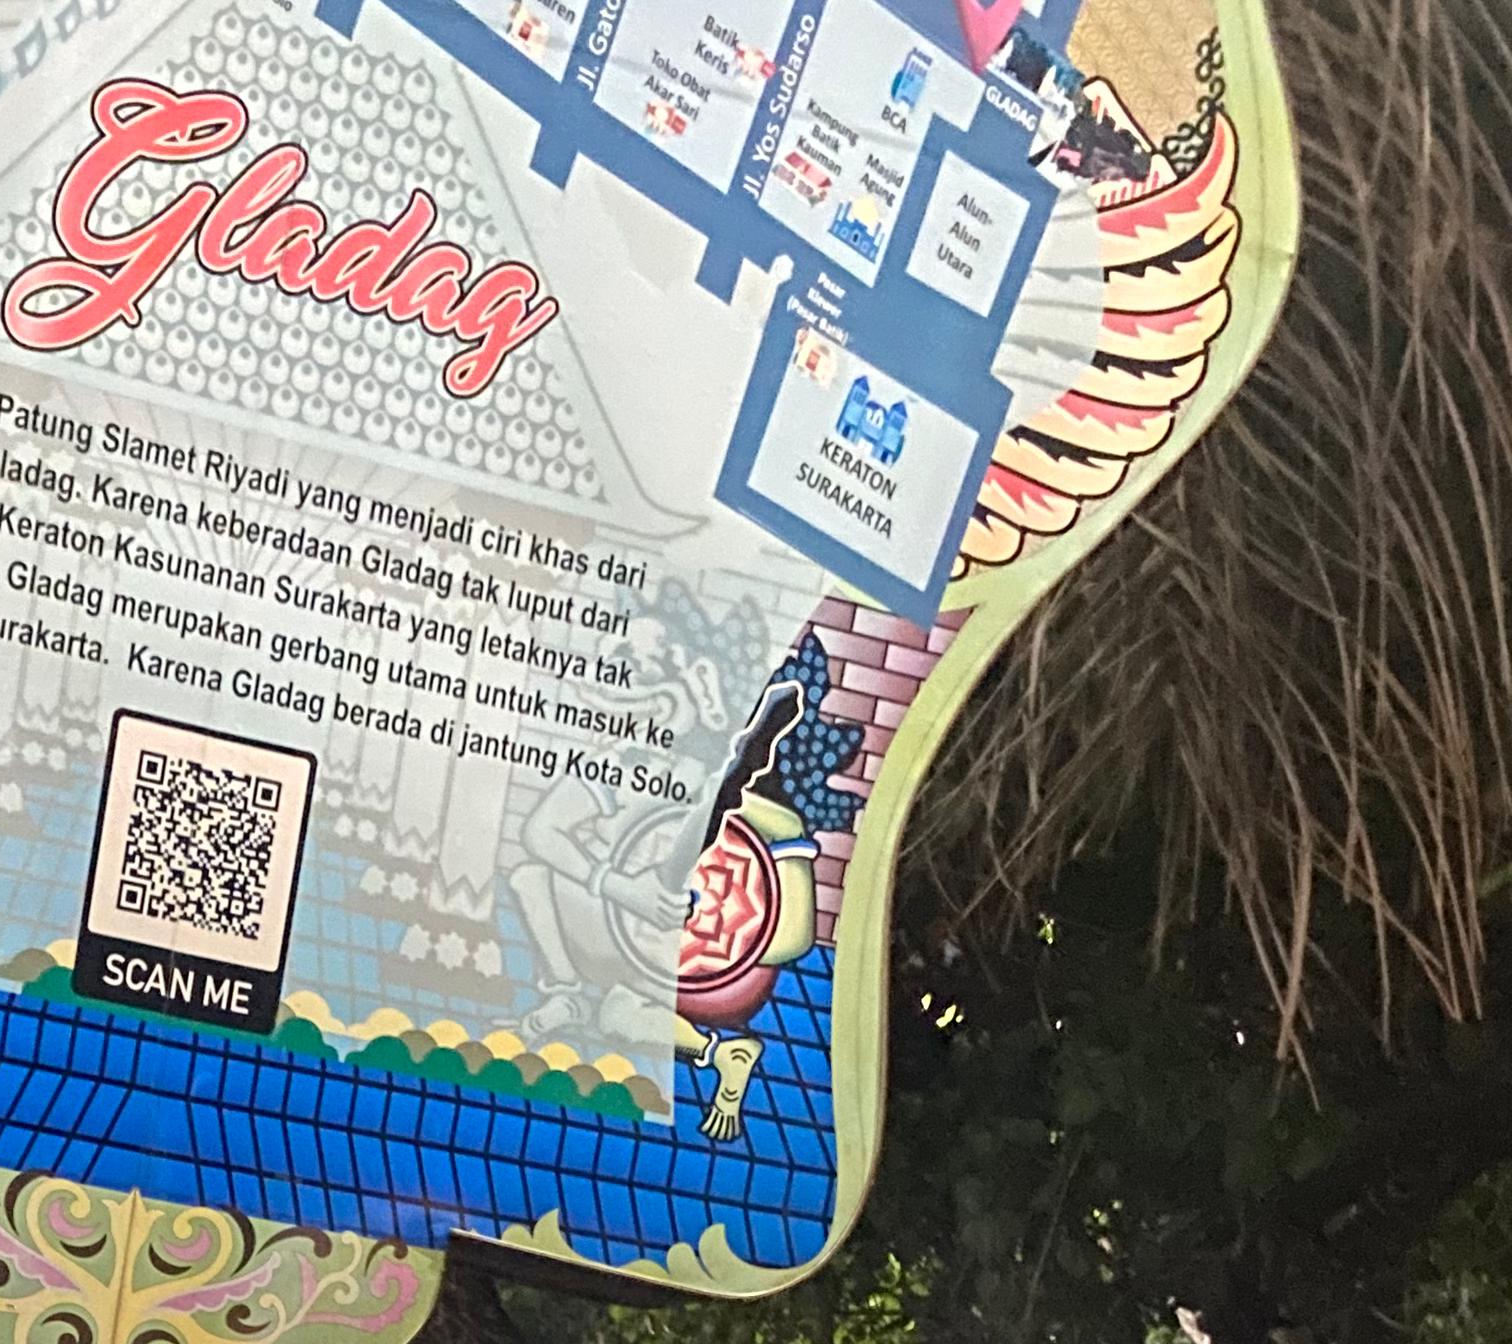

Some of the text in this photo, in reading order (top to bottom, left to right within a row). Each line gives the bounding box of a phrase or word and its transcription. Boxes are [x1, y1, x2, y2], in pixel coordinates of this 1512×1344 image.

[703, 14, 739, 48] Batik
[577, 66, 599, 91] Jl.
[650, 49, 711, 102] Toko Obat
[695, 39, 730, 75] Keris
[644, 75, 701, 122] Akar Sari
[742, 14, 816, 200] Jl. Yos Sudarso
[881, 104, 907, 134] BCA
[986, 85, 1038, 132] GLADAG
[807, 98, 859, 147] Kampung
[811, 124, 840, 154] Batik
[797, 135, 842, 177] Kauman
[866, 153, 905, 188] Masjid
[860, 172, 896, 208] Agung
[956, 192, 993, 225] Alun-
[2, 78, 559, 399] Gladag
[948, 220, 981, 252] Alun
[937, 244, 974, 280] Utara
[819, 436, 897, 501] KERATON
[102, 423, 197, 474] Slamet
[204, 449, 290, 498] Riyadi
[294, 480, 361, 524] yang
[369, 500, 474, 545] menjadi
[481, 525, 522, 557] ciri
[529, 533, 589, 575] khas
[597, 554, 647, 590] dari
[795, 462, 893, 539] SURAKARTA
[92, 473, 188, 525] Karena
[197, 500, 352, 567] keberadaan
[362, 544, 453, 599] Gladag
[462, 571, 500, 605] tak
[508, 580, 574, 624] luput
[581, 601, 630, 637] dari
[114, 533, 265, 598] Kasunanan
[274, 575, 401, 631] Surakarta
[407, 614, 473, 656] yang
[480, 625, 587, 680] letaknya
[595, 656, 632, 689] tak
[7, 560, 104, 617] Gladag
[111, 593, 262, 650] merupakan
[270, 633, 379, 685] gerbang
[388, 660, 467, 700] utama
[475, 683, 547, 719] untuk
[555, 702, 638, 741] masuk
[645, 717, 674, 749] ke
[127, 642, 223, 692] Karena
[232, 669, 325, 723] Gladag
[333, 692, 422, 740] berada
[430, 718, 453, 747] di
[458, 721, 558, 778] jantung
[565, 748, 623, 787] Kota
[631, 764, 692, 804] Solo.
[102, 953, 253, 1015] SCAN ME
